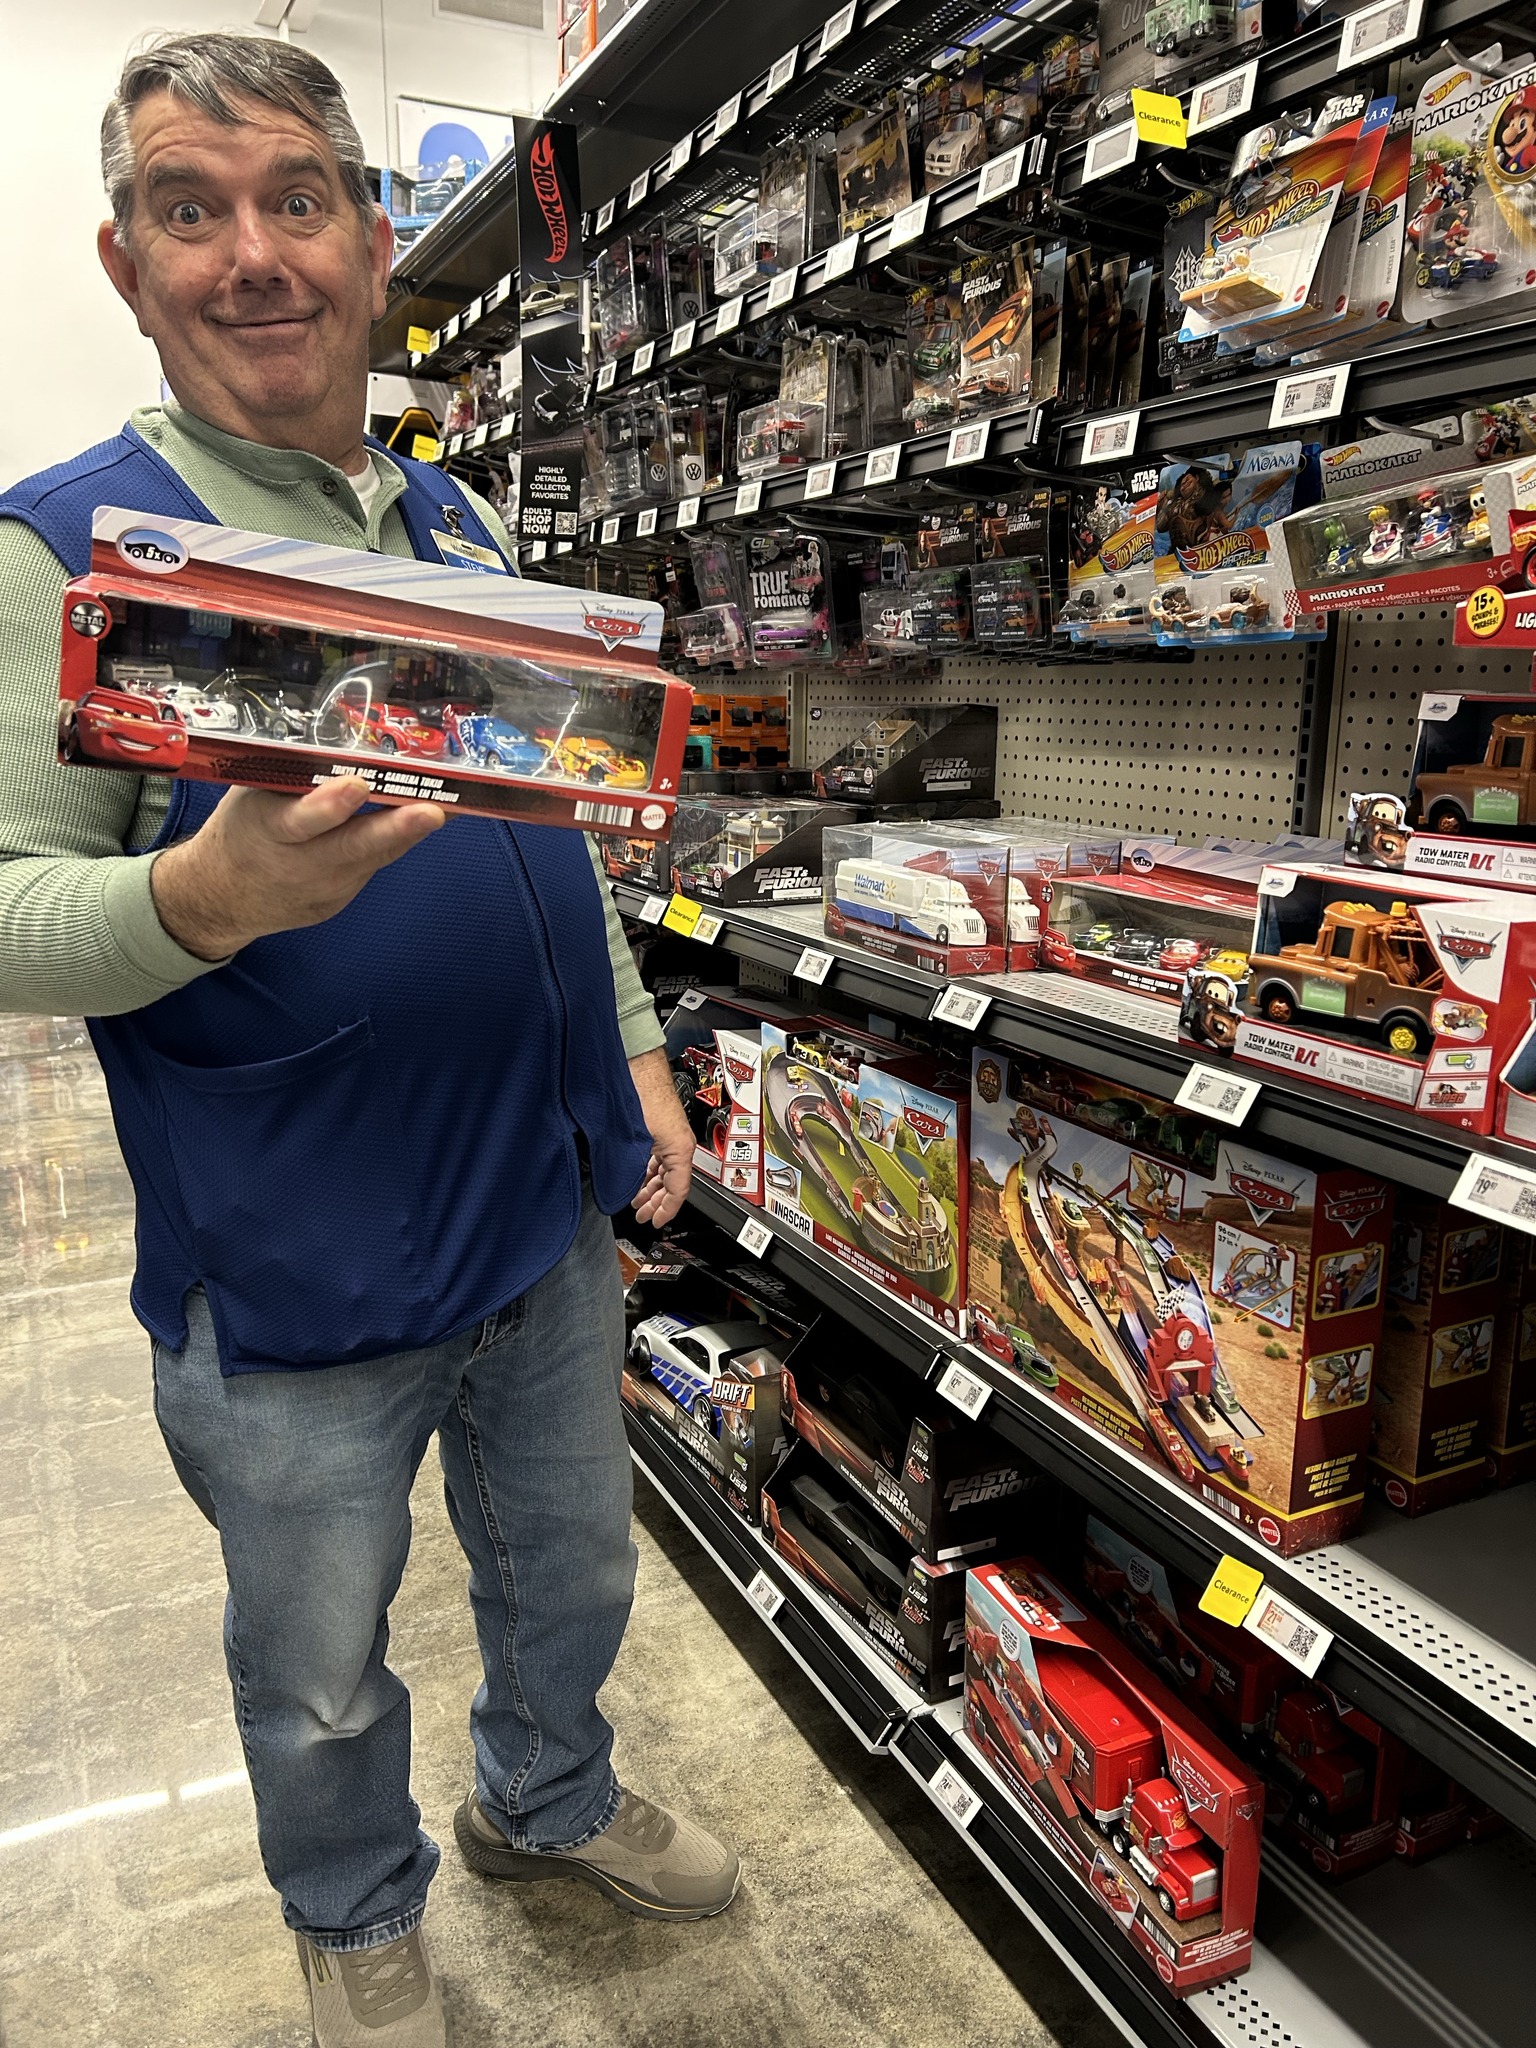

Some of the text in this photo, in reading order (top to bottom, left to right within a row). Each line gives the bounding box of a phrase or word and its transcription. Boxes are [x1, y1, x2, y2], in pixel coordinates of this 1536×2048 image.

[1325, 94, 1366, 113] STAR
[1138, 111, 1181, 127] Clearance
[1323, 106, 1363, 125] WARS
[962, 276, 986, 295] FAST
[963, 278, 1002, 304] FURIOUS
[538, 466, 564, 474] HIGHLY
[1249, 454, 1294, 473] MOANA
[1326, 449, 1421, 483] MARIOKART
[534, 475, 567, 483] DETAILED
[1133, 469, 1158, 483] STAR
[529, 483, 571, 492] COLLECTOR
[1131, 479, 1157, 493] WARS
[531, 492, 569, 500] FAVORITES
[522, 514, 552, 524] SHOP
[1005, 513, 1026, 527] FAST
[1007, 520, 1042, 535] FURIOUS
[522, 525, 550, 534] NOW
[939, 527, 957, 538] FAST
[940, 532, 969, 547] FURIOUS
[146, 547, 161, 561] 5x
[1198, 547, 1217, 568] HOT
[1236, 553, 1264, 566] VERSE
[1487, 567, 1499, 579] 3+
[750, 570, 790, 596] TRUE
[754, 592, 811, 608] romance
[1309, 583, 1385, 603] MARIOKART
[1334, 600, 1360, 609] PAQUETE
[1361, 598, 1370, 606] DE
[1430, 585, 1461, 595] PACOTES
[1473, 593, 1495, 610] 15+
[71, 613, 105, 627] METAL
[588, 618, 634, 634] Cars
[919, 757, 961, 773] FAST
[356, 766, 378, 780] RACE
[384, 771, 420, 786] CARRERA
[421, 778, 444, 789] TOKIO
[660, 778, 673, 790] 3+
[922, 767, 991, 784] FURIOUS
[383, 783, 418, 797] CORRIDA
[418, 788, 431, 798] EM
[642, 812, 665, 821] MATTEL
[1415, 856, 1467, 868] RADIO CONTROL
[1419, 847, 1469, 860] TOW MATER
[1468, 853, 1495, 871] R/C
[753, 866, 801, 882] FAST
[757, 876, 833, 894] FURIOUS
[854, 873, 885, 893] Walmart
[669, 907, 695, 924] Clearance
[1443, 939, 1485, 954] Cars
[1244, 1041, 1293, 1061] RADIO CONTROL
[1248, 1032, 1295, 1053] TOW MATER
[1295, 1047, 1320, 1068] R/C
[726, 1060, 751, 1080] Cars
[906, 1111, 941, 1136] Cars
[1461, 1118, 1472, 1127] 6+
[731, 1148, 752, 1161] USB
[1243, 1161, 1285, 1184] Disney PIXAR
[1234, 1178, 1287, 1207] Cars
[1331, 1200, 1377, 1217] Cars
[775, 1200, 811, 1236] NASCAR
[1217, 1235, 1226, 1243] 37
[1227, 1237, 1234, 1245] in
[1218, 1225, 1236, 1239] 96 cm
[712, 1381, 750, 1406] DRIFT
[674, 1410, 706, 1439] FAST
[679, 1423, 725, 1476] FURIOUS
[912, 1444, 929, 1462] USB
[729, 1473, 748, 1493] USB
[873, 1464, 906, 1497] FAST
[944, 1467, 1012, 1499] FAST
[949, 1474, 1048, 1512] FURIOUS
[877, 1480, 927, 1536] FURIOUS
[1260, 1527, 1280, 1537] MATTEL
[907, 1585, 928, 1604] USB
[1213, 1579, 1250, 1604] Clearance
[865, 1600, 902, 1638] FAST
[868, 1616, 927, 1675] FURIOUS
[1175, 1768, 1209, 1804] Cars
